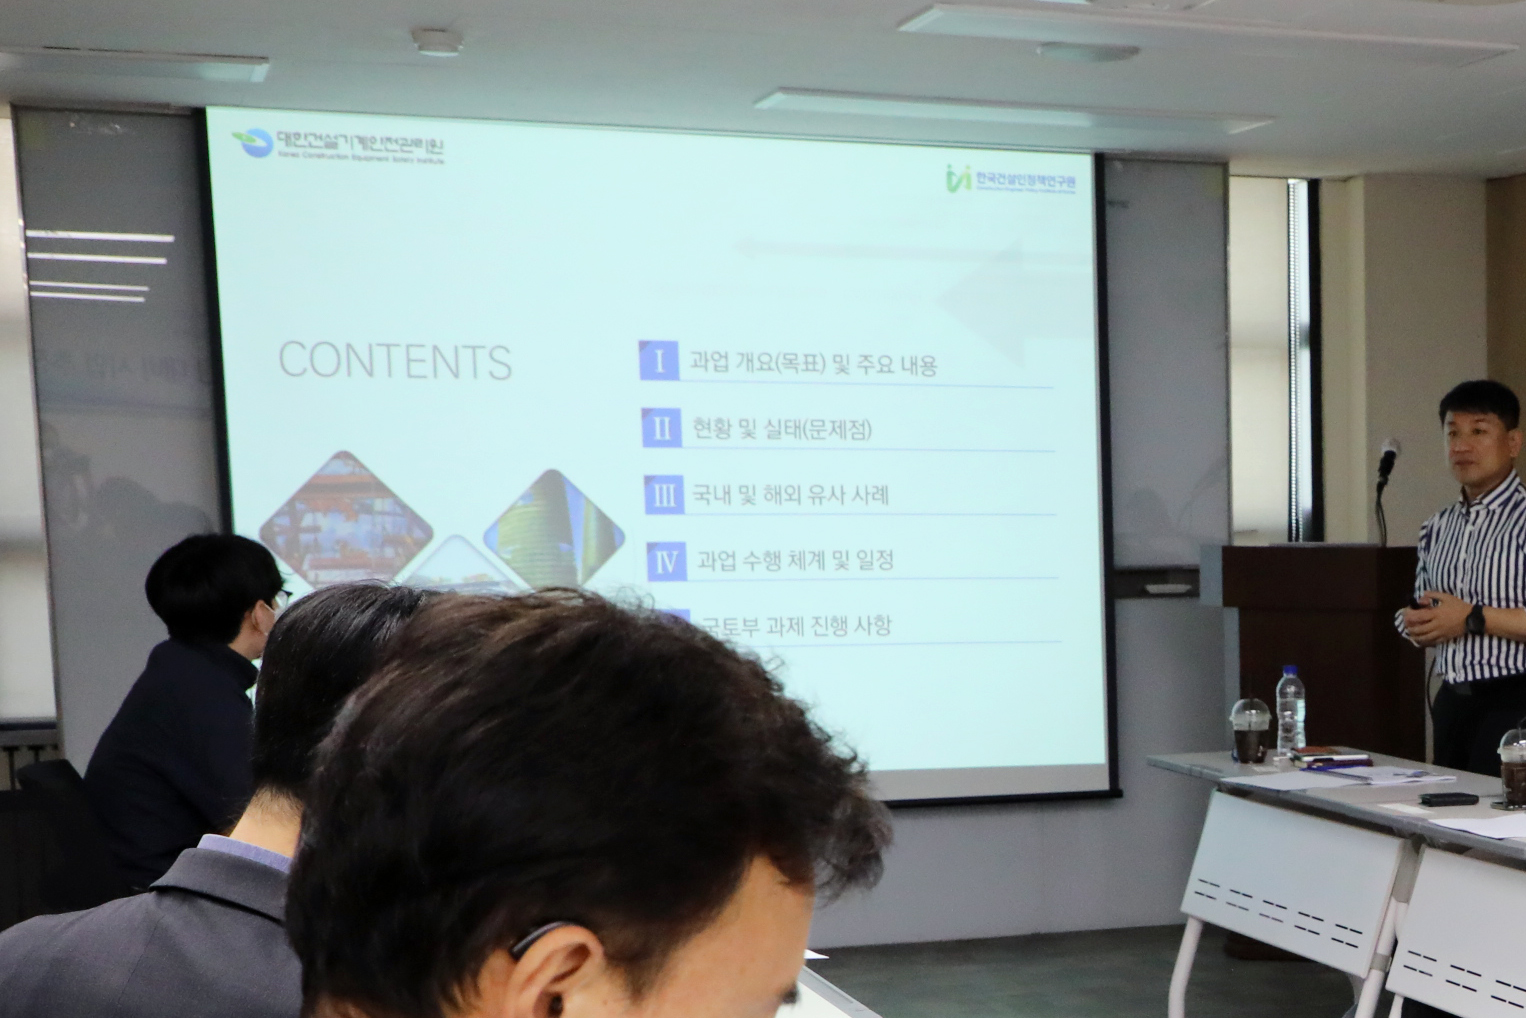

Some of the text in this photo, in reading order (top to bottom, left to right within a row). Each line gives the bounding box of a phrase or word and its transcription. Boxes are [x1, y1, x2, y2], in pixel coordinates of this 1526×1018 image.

[279, 340, 513, 381] CONTENTS
[690, 351, 729, 373] 과업
[736, 351, 826, 374] 개요(목표)
[832, 353, 851, 375] 및
[856, 354, 895, 376] 주요
[901, 354, 938, 378] 내용
[693, 417, 732, 439] 현황
[738, 418, 757, 440] 및
[764, 418, 872, 441] 실태(문제점)
[692, 484, 731, 505] 국내
[738, 484, 757, 505] 및
[763, 484, 802, 505] 해외
[807, 484, 846, 506] 유사
[851, 484, 889, 506] 사례
[697, 551, 736, 572] 과업
[742, 550, 782, 572] 수행
[788, 549, 825, 571] 체계
[832, 550, 850, 571] 및
[856, 549, 894, 571] 일정
[702, 614, 893, 639] 국토부 과제 진행 사항
